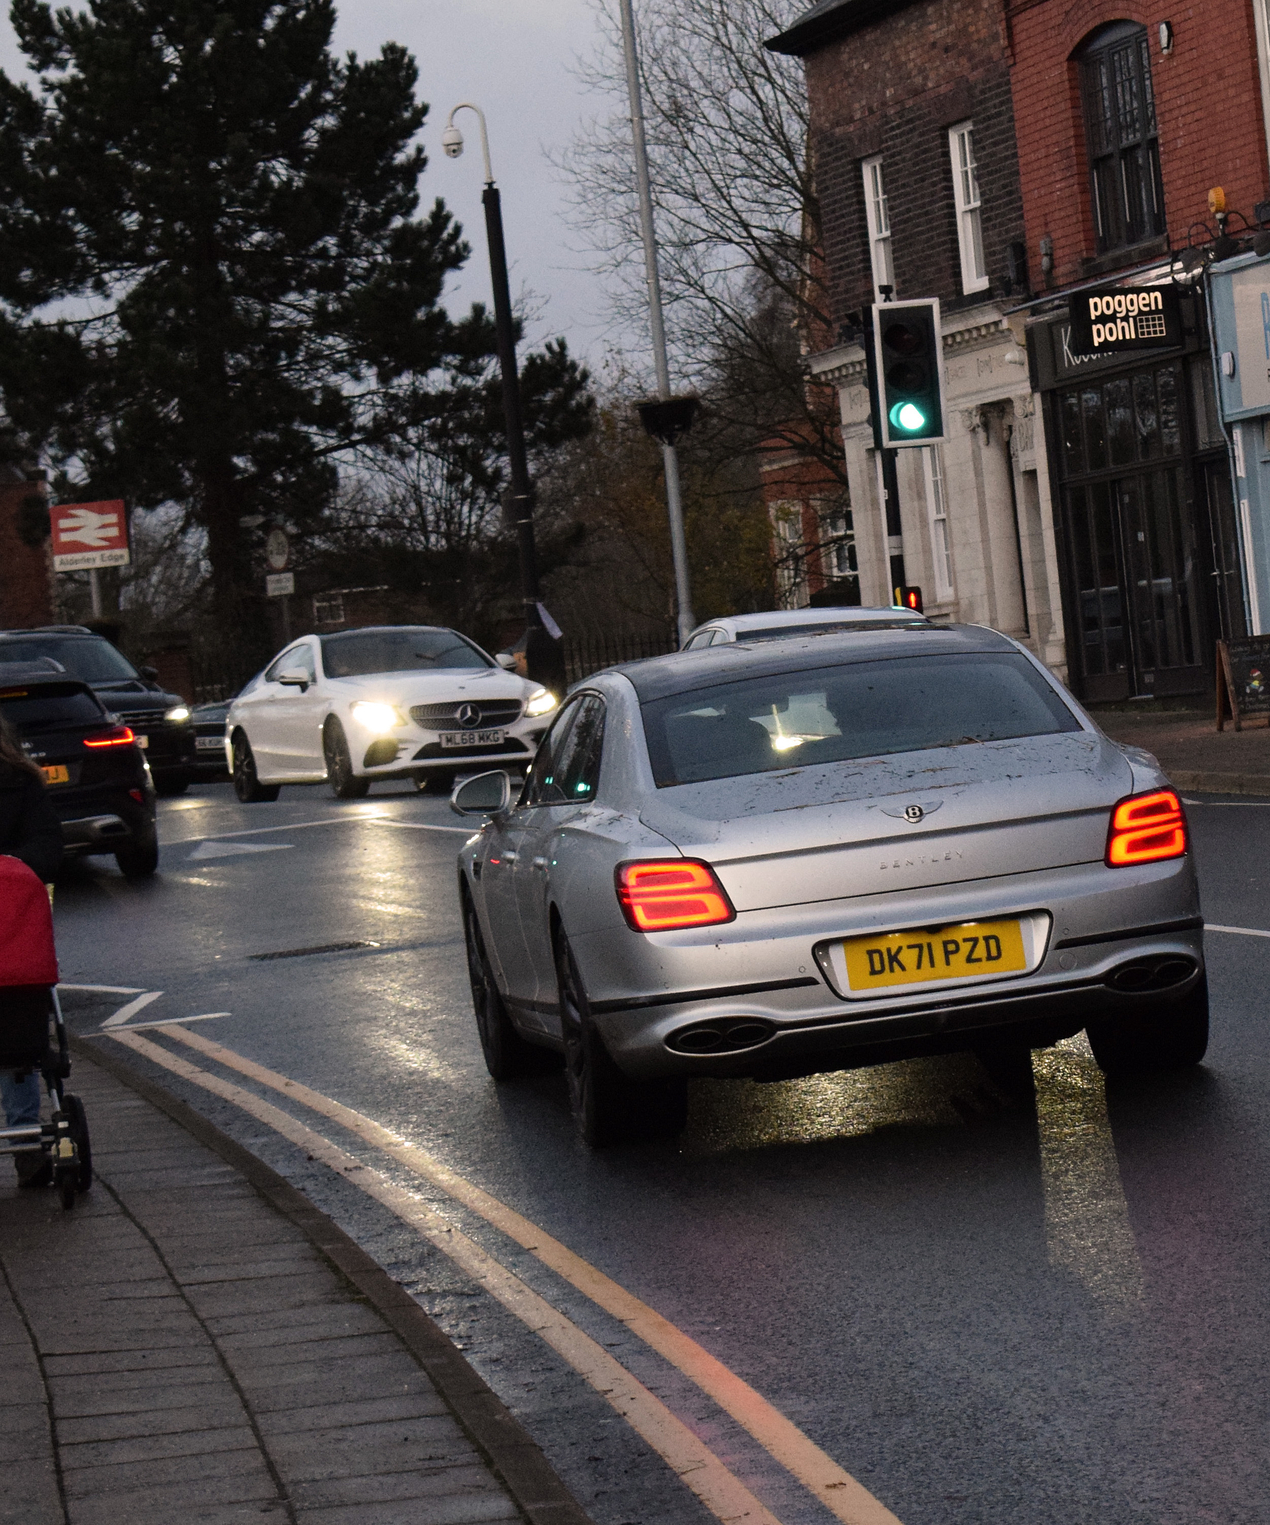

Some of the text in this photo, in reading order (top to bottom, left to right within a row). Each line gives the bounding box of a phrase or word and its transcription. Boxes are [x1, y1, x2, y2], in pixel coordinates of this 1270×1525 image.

[1089, 291, 1163, 320] poggen
[1092, 317, 1136, 346] pohl
[58, 552, 125, 567] Alderley Edge
[880, 849, 963, 870] BENTLEY
[866, 934, 1003, 976] DK71 PZD
